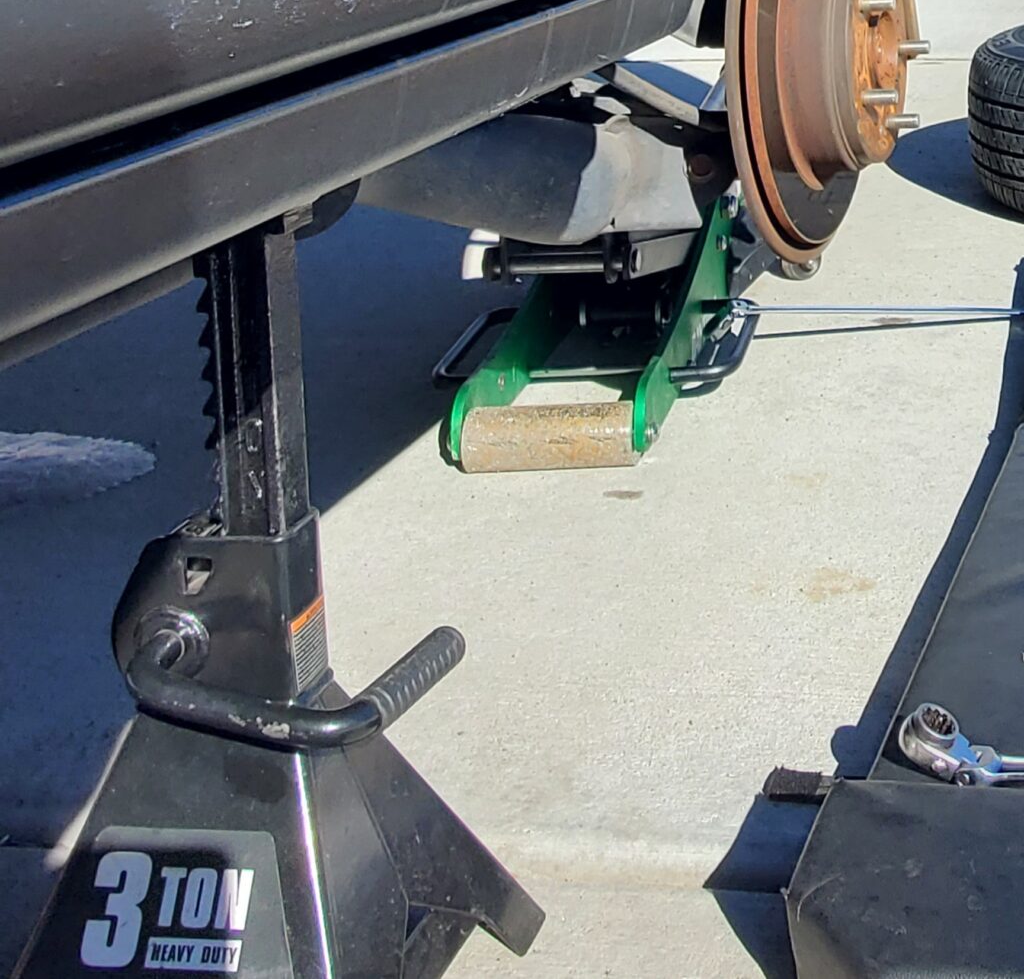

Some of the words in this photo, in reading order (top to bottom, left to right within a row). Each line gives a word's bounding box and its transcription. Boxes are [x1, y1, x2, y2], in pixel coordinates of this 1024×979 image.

[80, 850, 153, 968] 3
[157, 866, 255, 931] TON
[150, 943, 195, 963] HEAVY
[200, 944, 238, 965] DUTY
